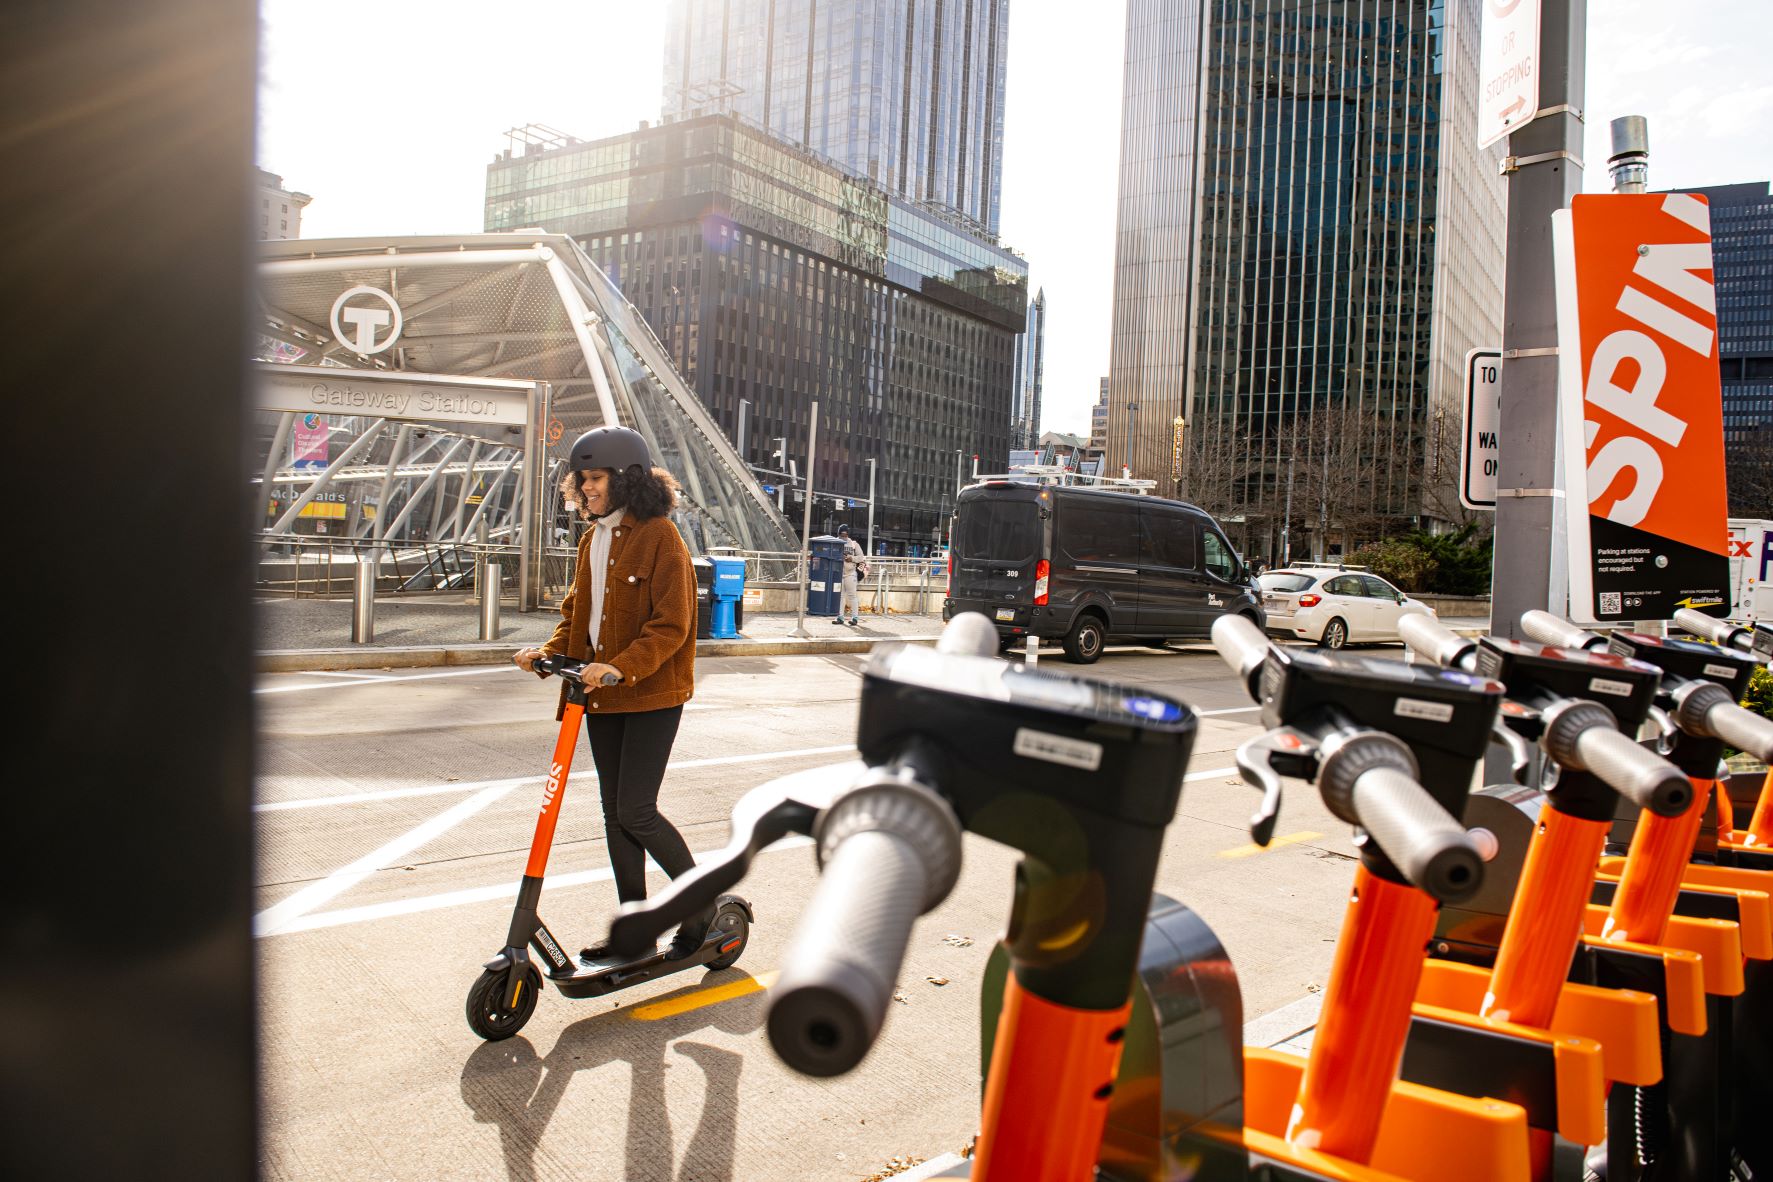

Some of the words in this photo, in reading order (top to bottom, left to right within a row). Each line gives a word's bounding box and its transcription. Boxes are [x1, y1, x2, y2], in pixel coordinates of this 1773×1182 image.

[1502, 31, 1516, 56] OR
[1486, 56, 1531, 103] STOPPING
[343, 307, 390, 353] T
[1585, 193, 1717, 527] SPIN
[310, 383, 411, 414] Gateway
[418, 390, 498, 415] Station
[1479, 432, 1497, 449] WA
[271, 489, 346, 502] McDald's
[1598, 557, 1633, 565] encouraged
[540, 762, 563, 815] SPIN
